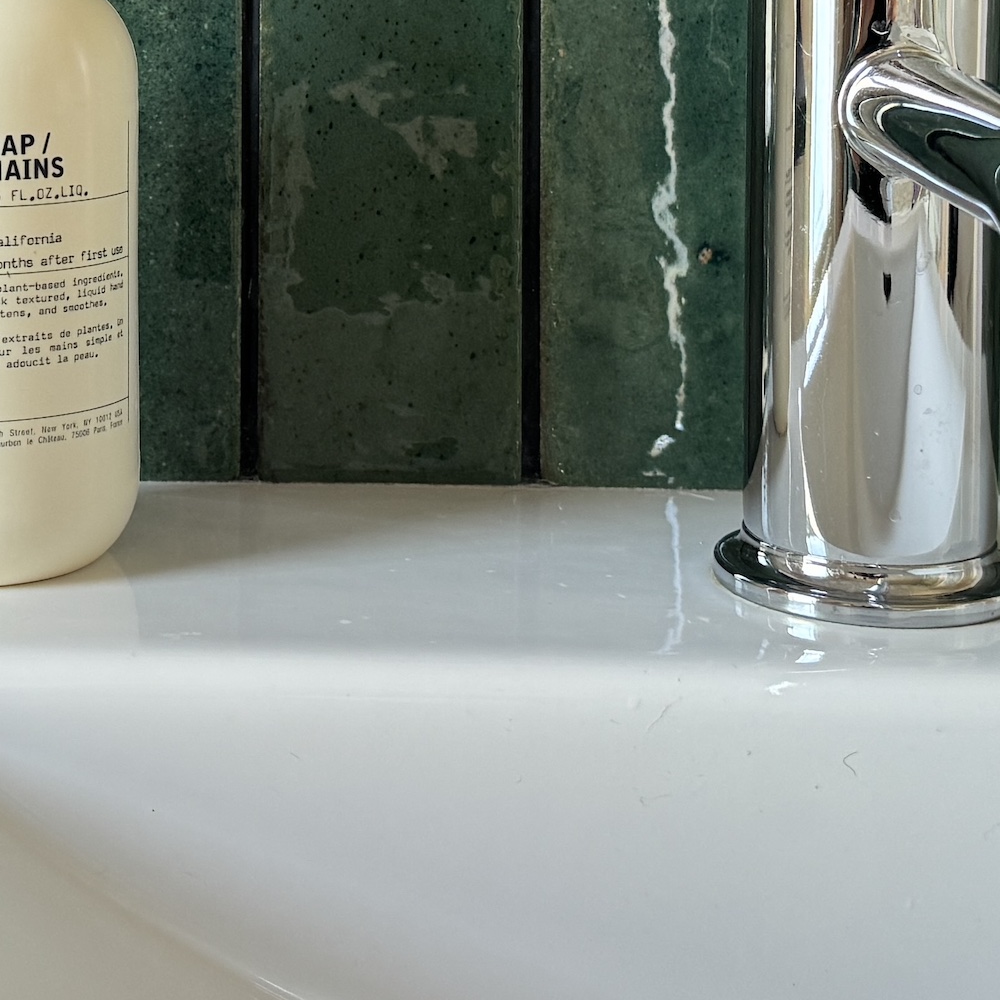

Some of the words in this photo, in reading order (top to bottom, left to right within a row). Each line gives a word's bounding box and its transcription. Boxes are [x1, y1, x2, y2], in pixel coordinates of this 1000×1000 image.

[40, 254, 74, 267] after
[81, 247, 107, 261] first
[111, 245, 123, 256] use
[16, 291, 70, 305] textured,
[77, 285, 106, 298] liquid
[39, 306, 57, 315] and
[60, 330, 71, 339] de
[22, 345, 41, 355] les
[49, 341, 78, 352] mains
[86, 334, 112, 347] simple
[6, 356, 51, 368] adoucit
[57, 354, 68, 363] la
